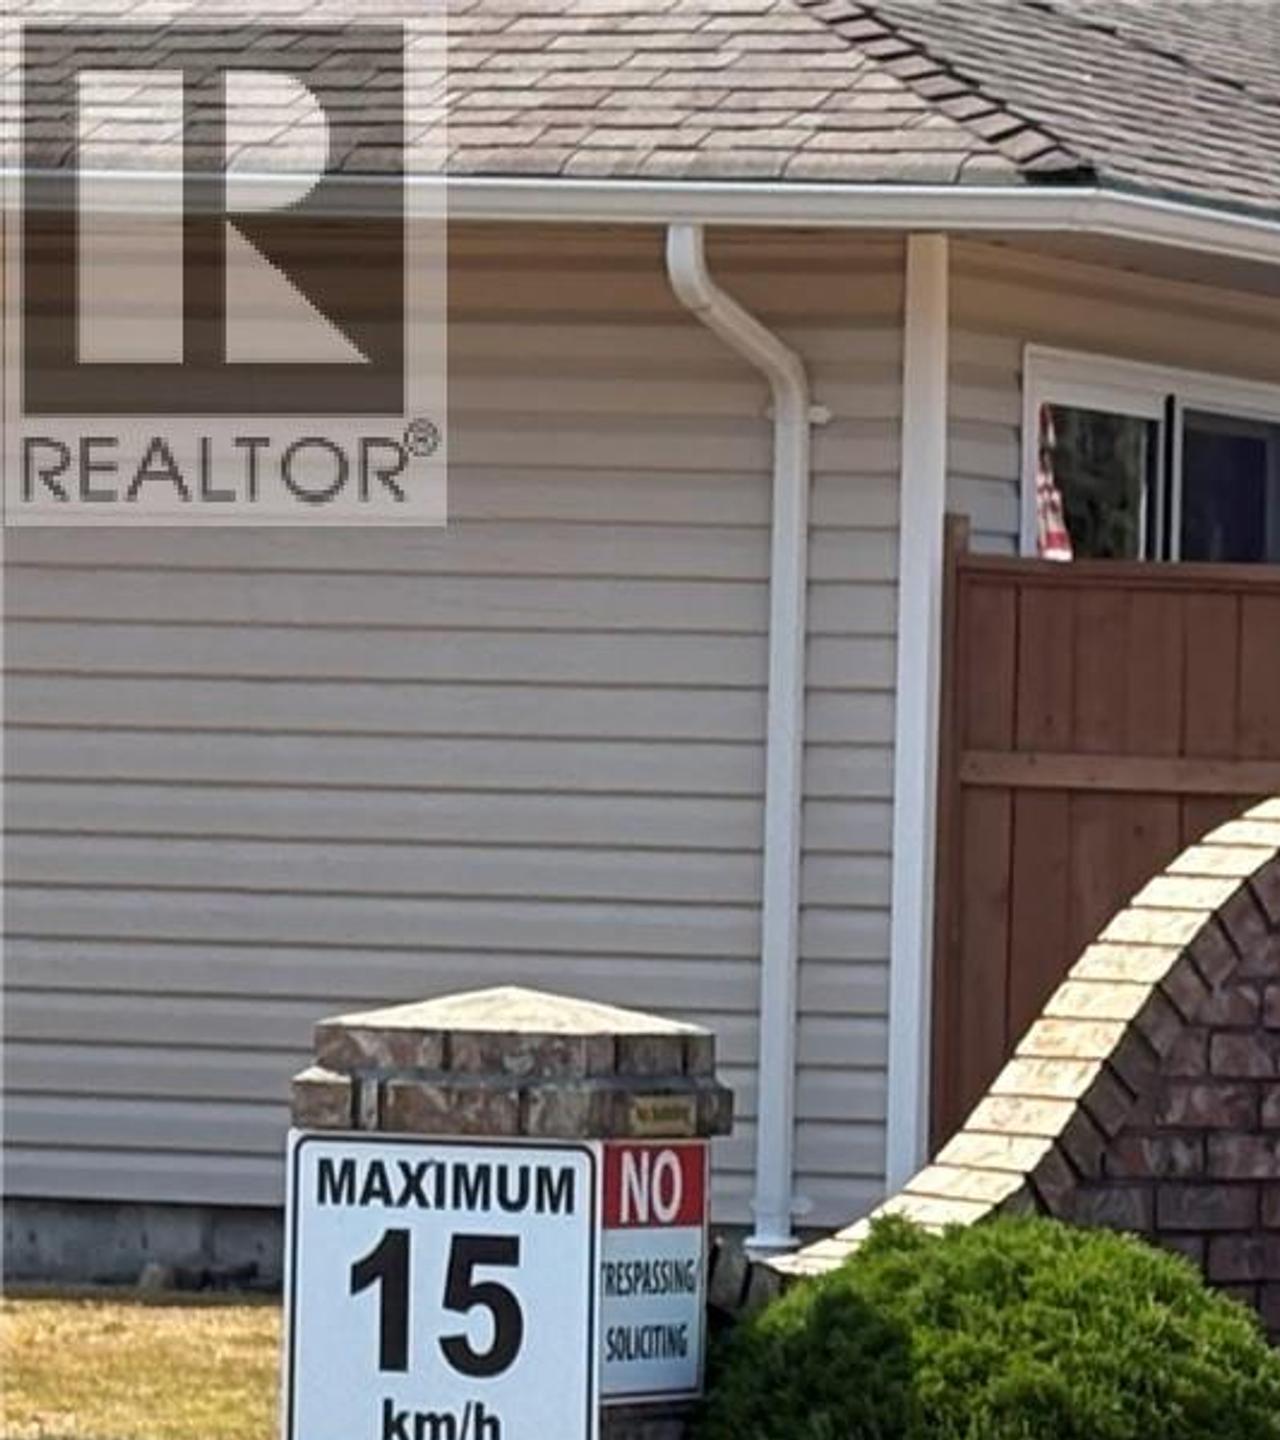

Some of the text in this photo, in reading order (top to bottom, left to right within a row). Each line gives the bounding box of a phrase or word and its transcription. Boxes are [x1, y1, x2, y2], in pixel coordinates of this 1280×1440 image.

[316, 1157, 576, 1215] MAXIMUM
[619, 1149, 683, 1225] NO
[349, 1228, 525, 1379] 15
[606, 1323, 688, 1362] SOLICITING
